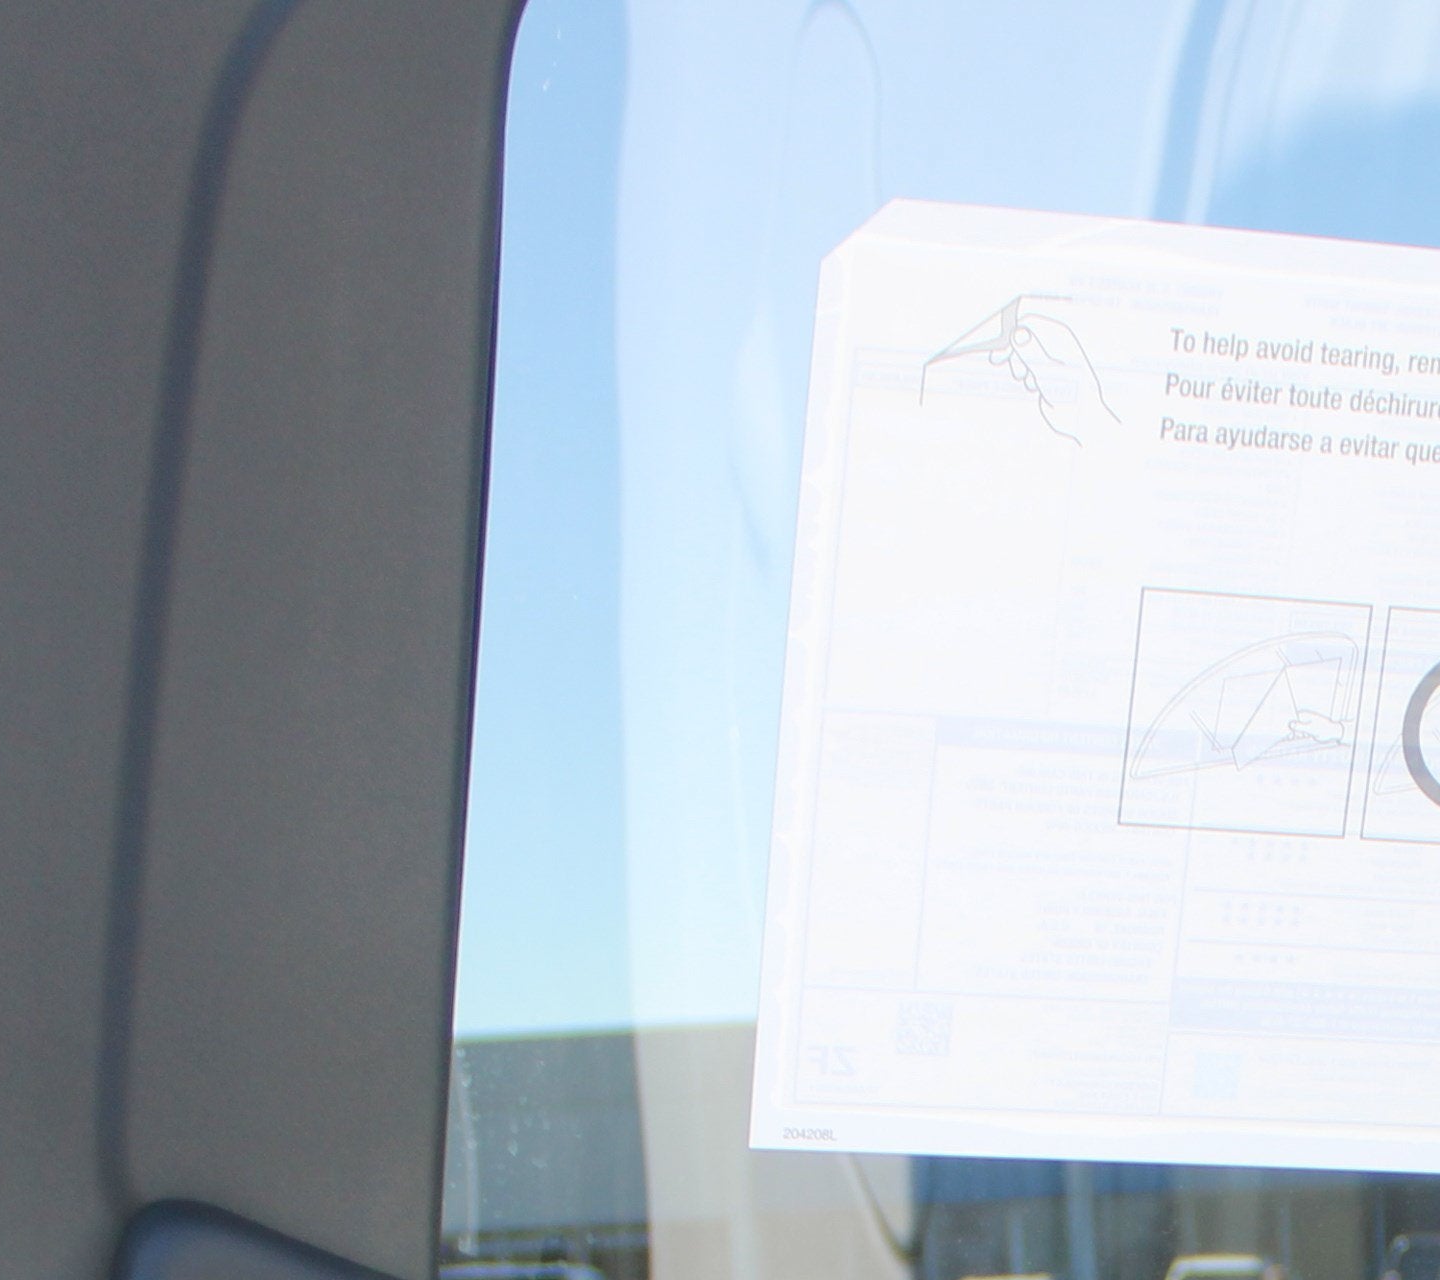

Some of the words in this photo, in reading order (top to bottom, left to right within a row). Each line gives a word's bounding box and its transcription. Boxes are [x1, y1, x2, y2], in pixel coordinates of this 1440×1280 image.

[1170, 327, 1196, 353] To
[1203, 332, 1249, 361] help
[1256, 339, 1313, 363] avoid
[1320, 342, 1400, 376] tearing,
[1165, 373, 1215, 399] Pour
[1221, 377, 1283, 405] éviter
[1289, 383, 1342, 411] toute
[1160, 416, 1208, 443] Para
[1215, 425, 1313, 453] ayudarse
[1320, 435, 1332, 454] a
[1340, 434, 1399, 460] evitar
